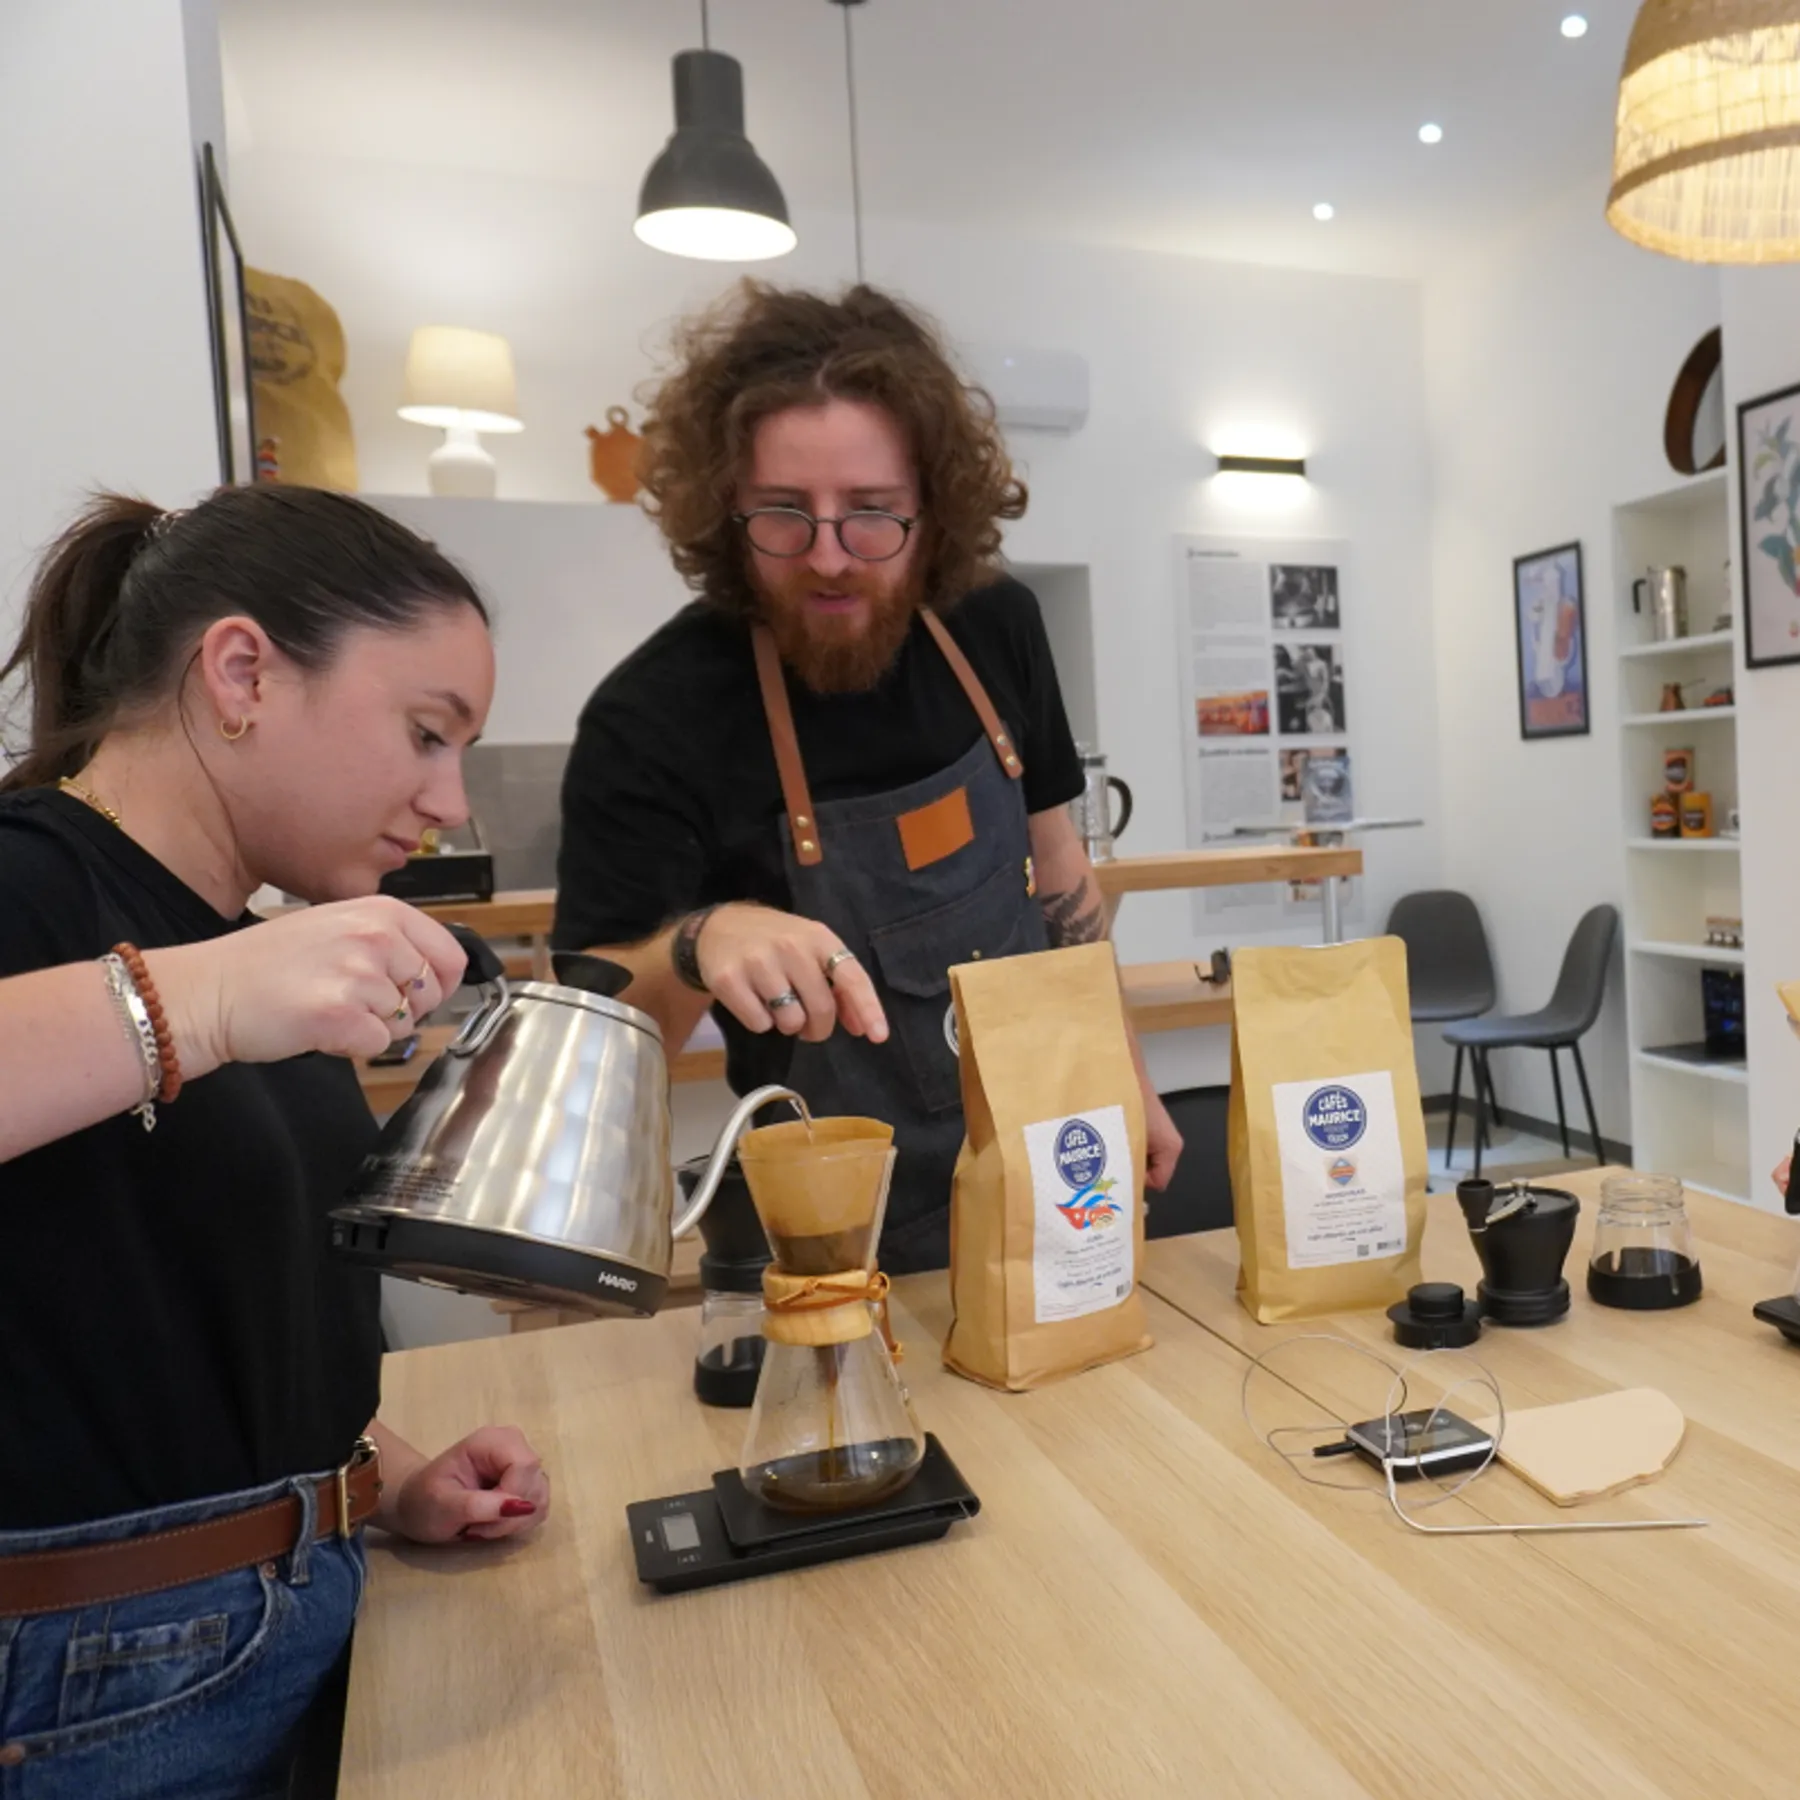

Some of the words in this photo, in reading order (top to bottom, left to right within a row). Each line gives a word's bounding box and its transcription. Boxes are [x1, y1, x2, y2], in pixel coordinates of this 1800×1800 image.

[1309, 1109, 1360, 1127] MAURICE
[1060, 1143, 1101, 1164] MAURICE
[598, 1271, 638, 1292] HARIO
